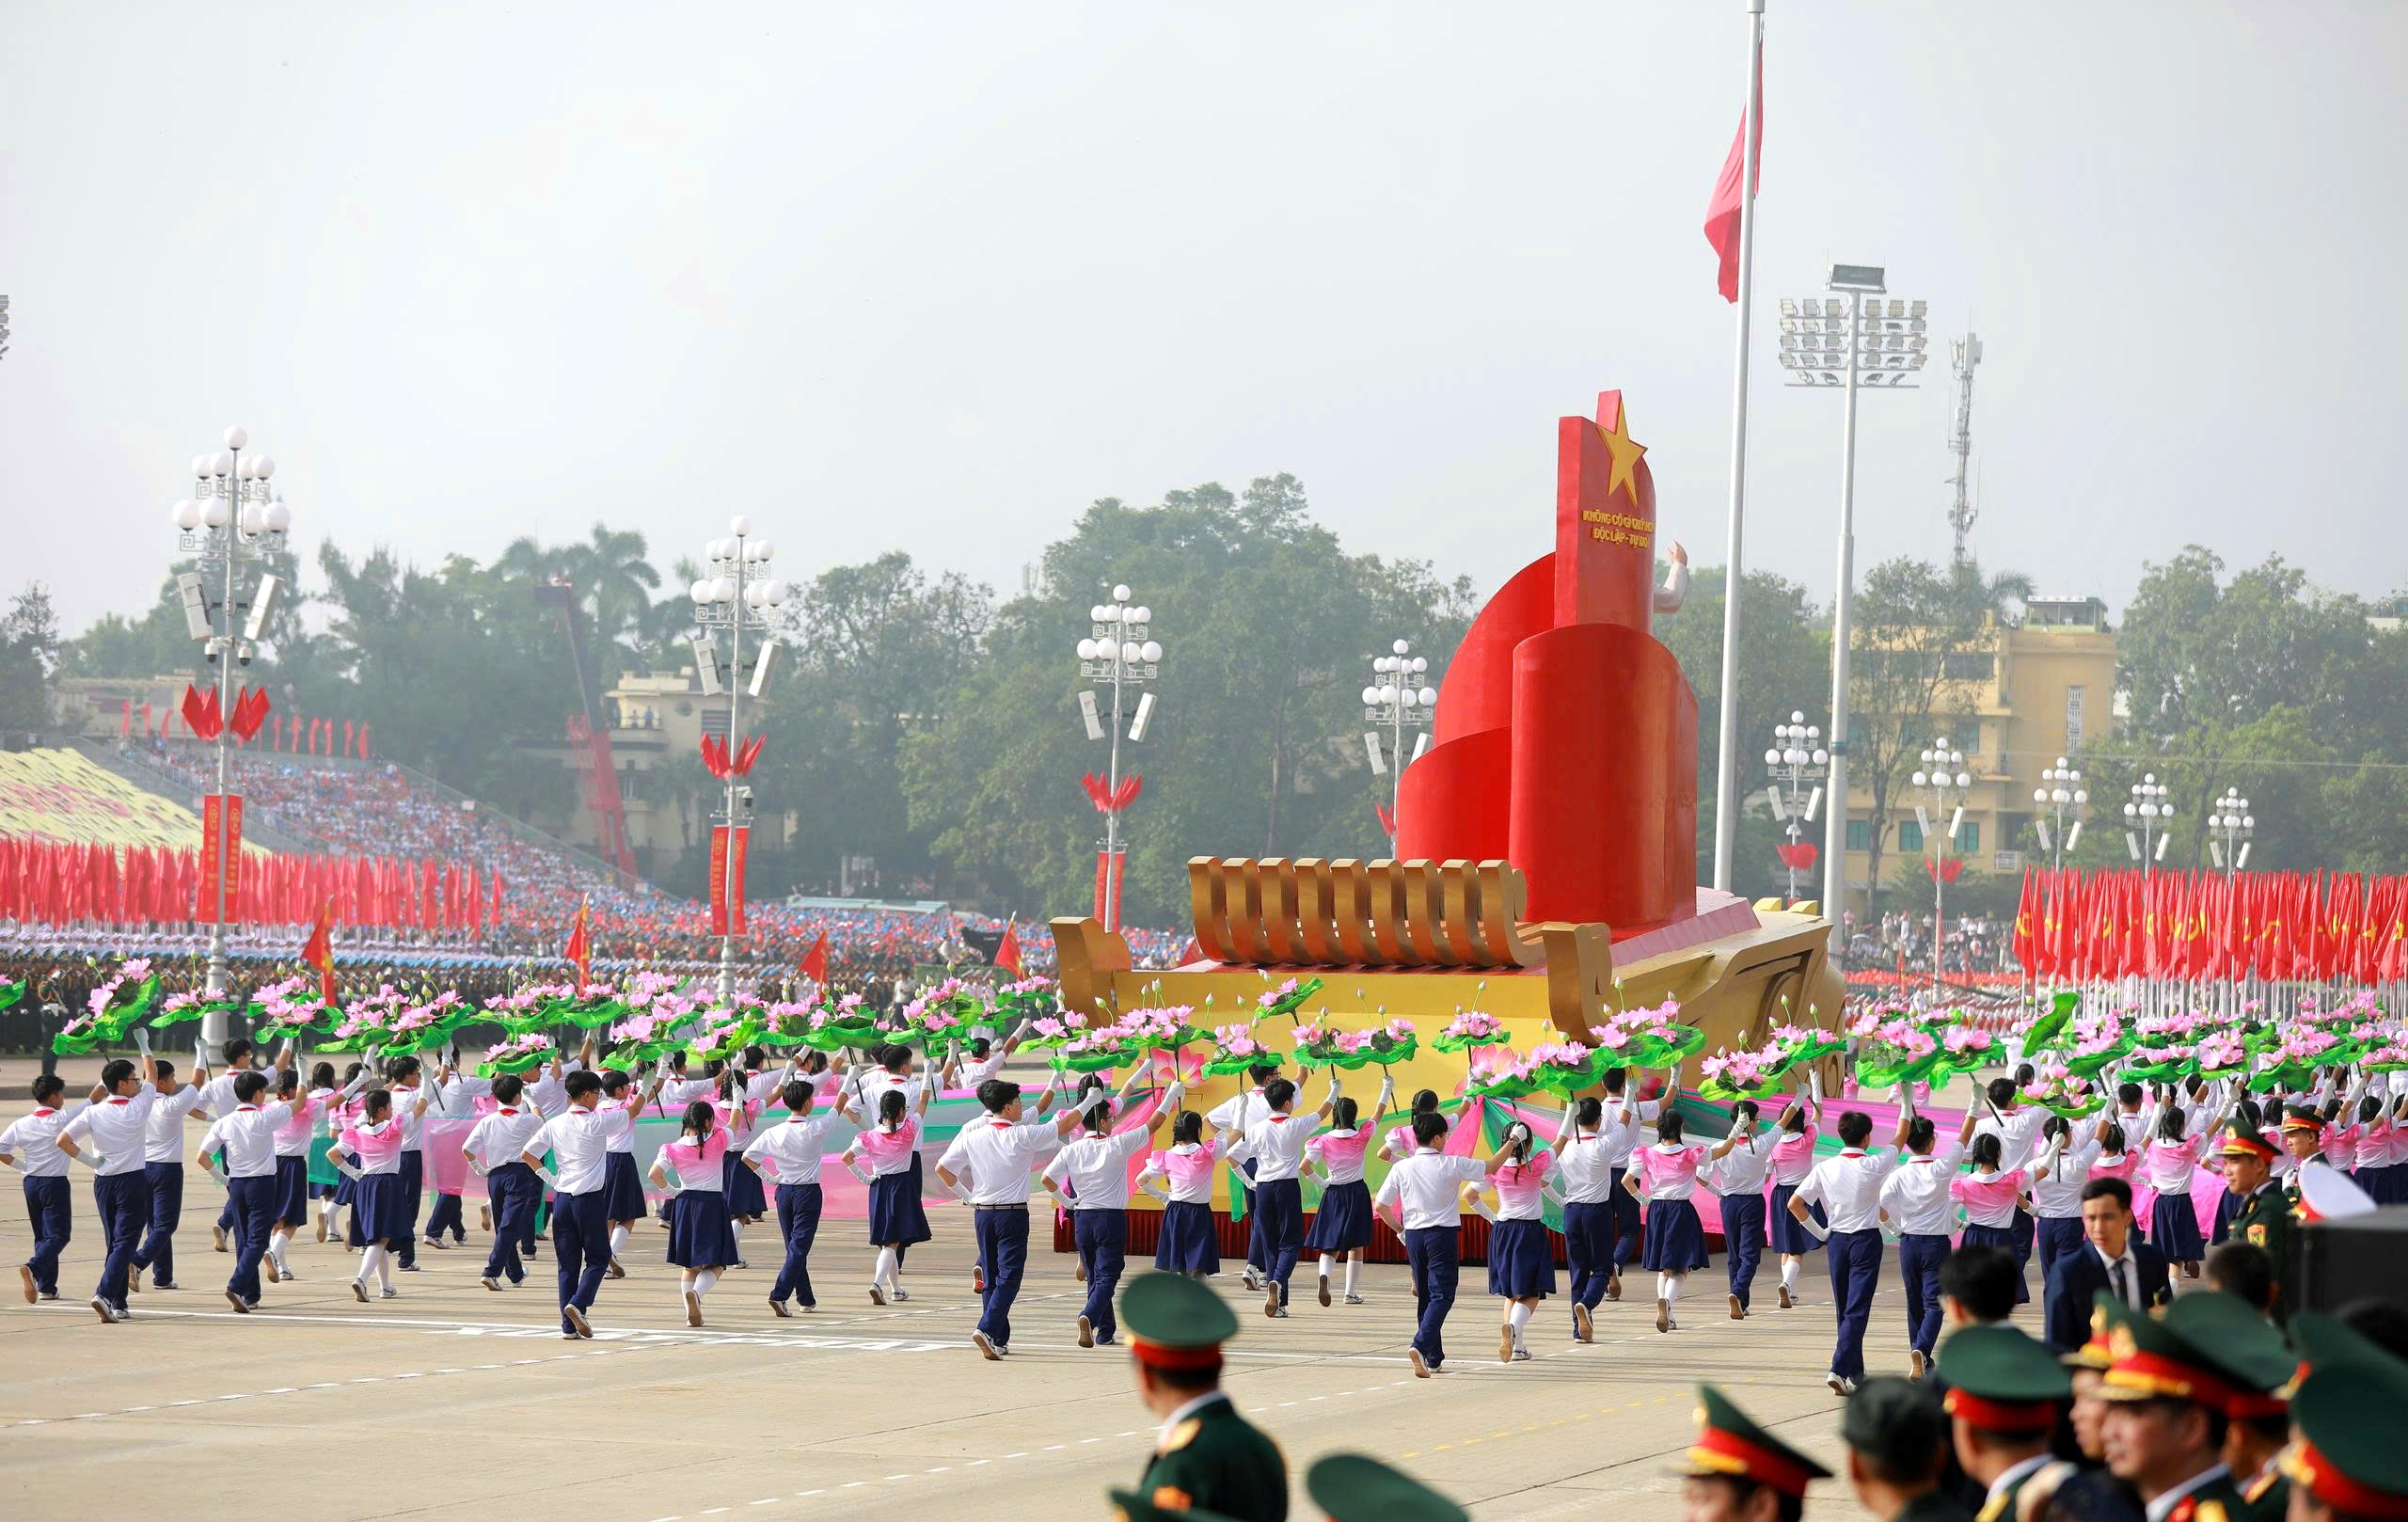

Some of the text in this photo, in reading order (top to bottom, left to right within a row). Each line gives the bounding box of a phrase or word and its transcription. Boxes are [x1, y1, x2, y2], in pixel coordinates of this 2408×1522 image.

[1582, 509, 1611, 525] KHÔNG
[1611, 513, 1624, 527] CÓ
[1593, 526, 1610, 542] ĐỘC
[1610, 529, 1625, 545] LẬP
